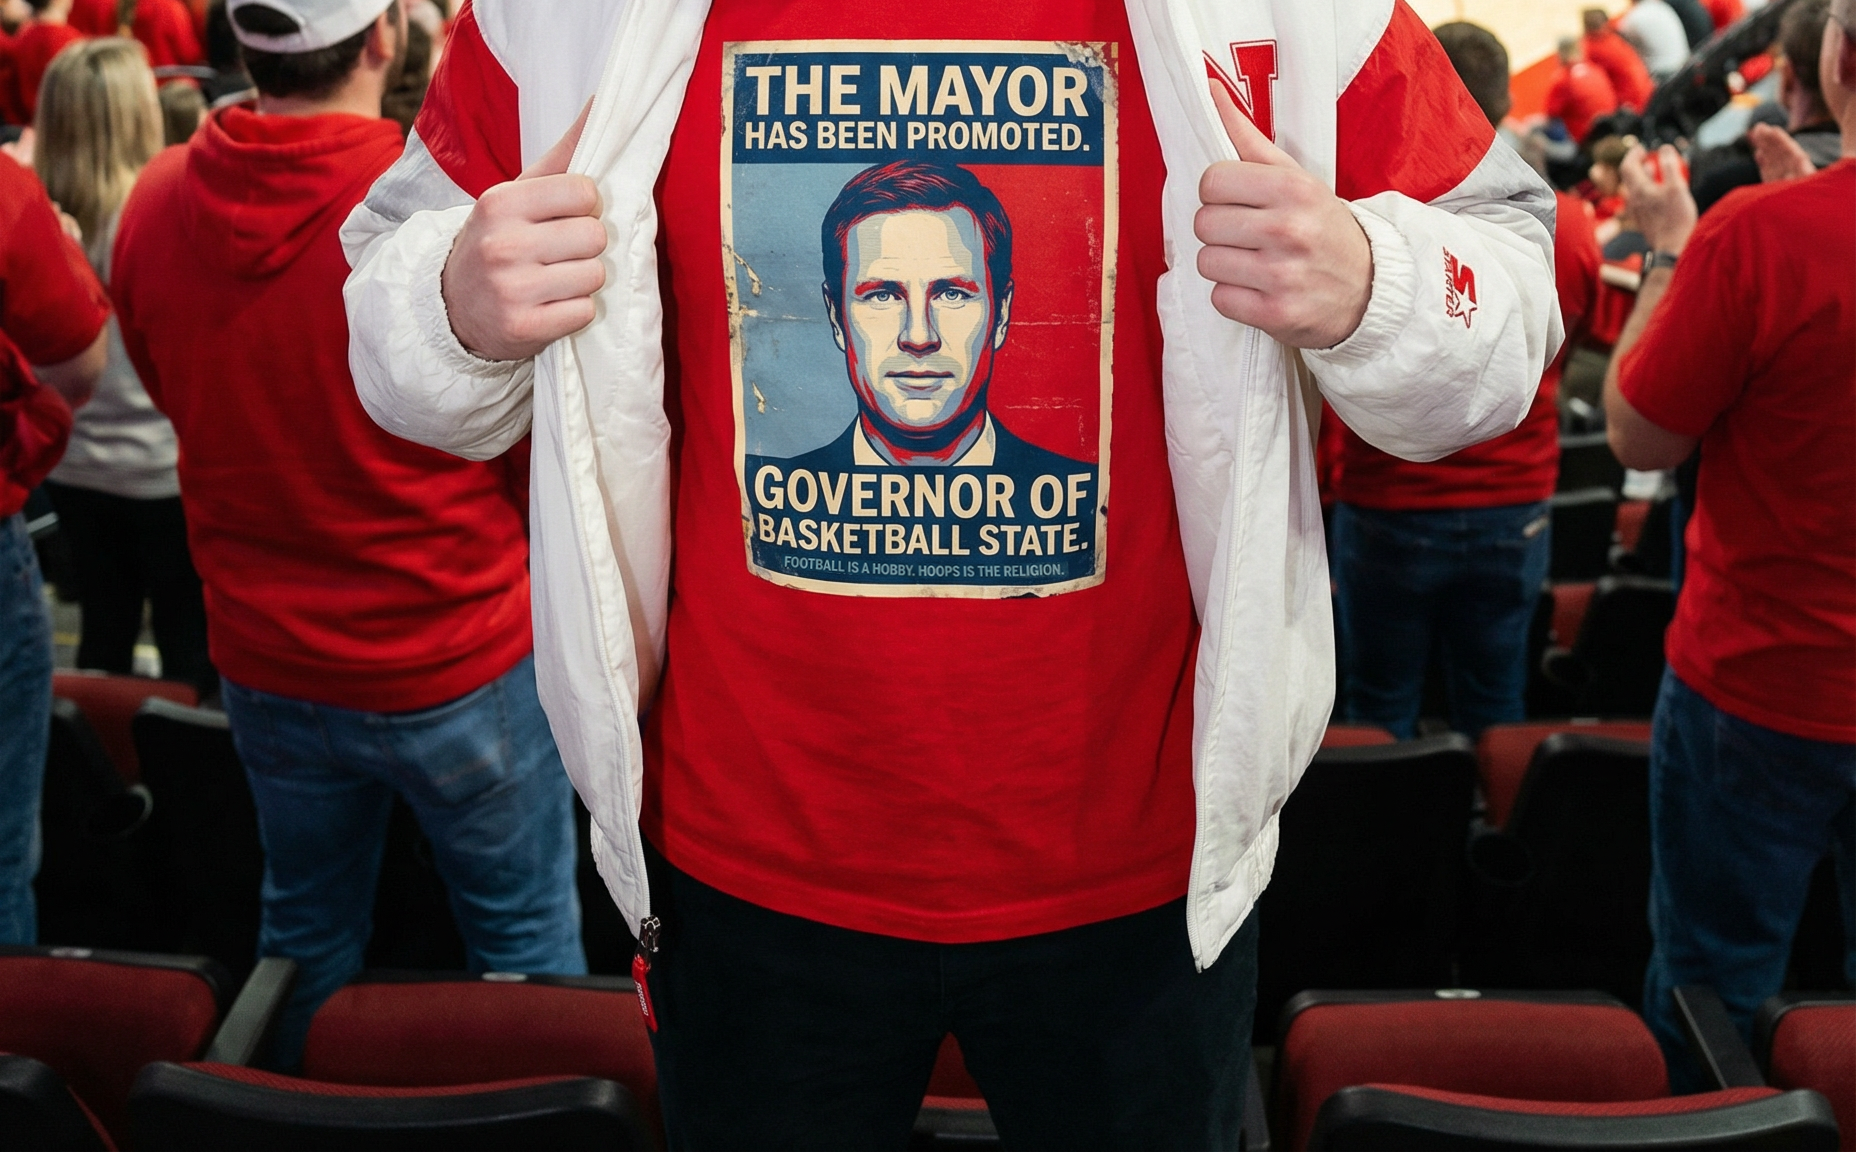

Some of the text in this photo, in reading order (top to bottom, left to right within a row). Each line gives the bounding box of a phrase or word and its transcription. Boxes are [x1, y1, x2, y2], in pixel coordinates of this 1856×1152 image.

[746, 65, 1089, 117] THE MAYOR
[745, 121, 1090, 151] HAS BEEN PROMOTED.
[754, 464, 1092, 519] GOVERNOR OF
[758, 512, 1089, 556] BASKETBALL STATE.
[784, 555, 1065, 577] FOOTBALL IS A HOBBY. HOOPS IS THE RELIGION.
